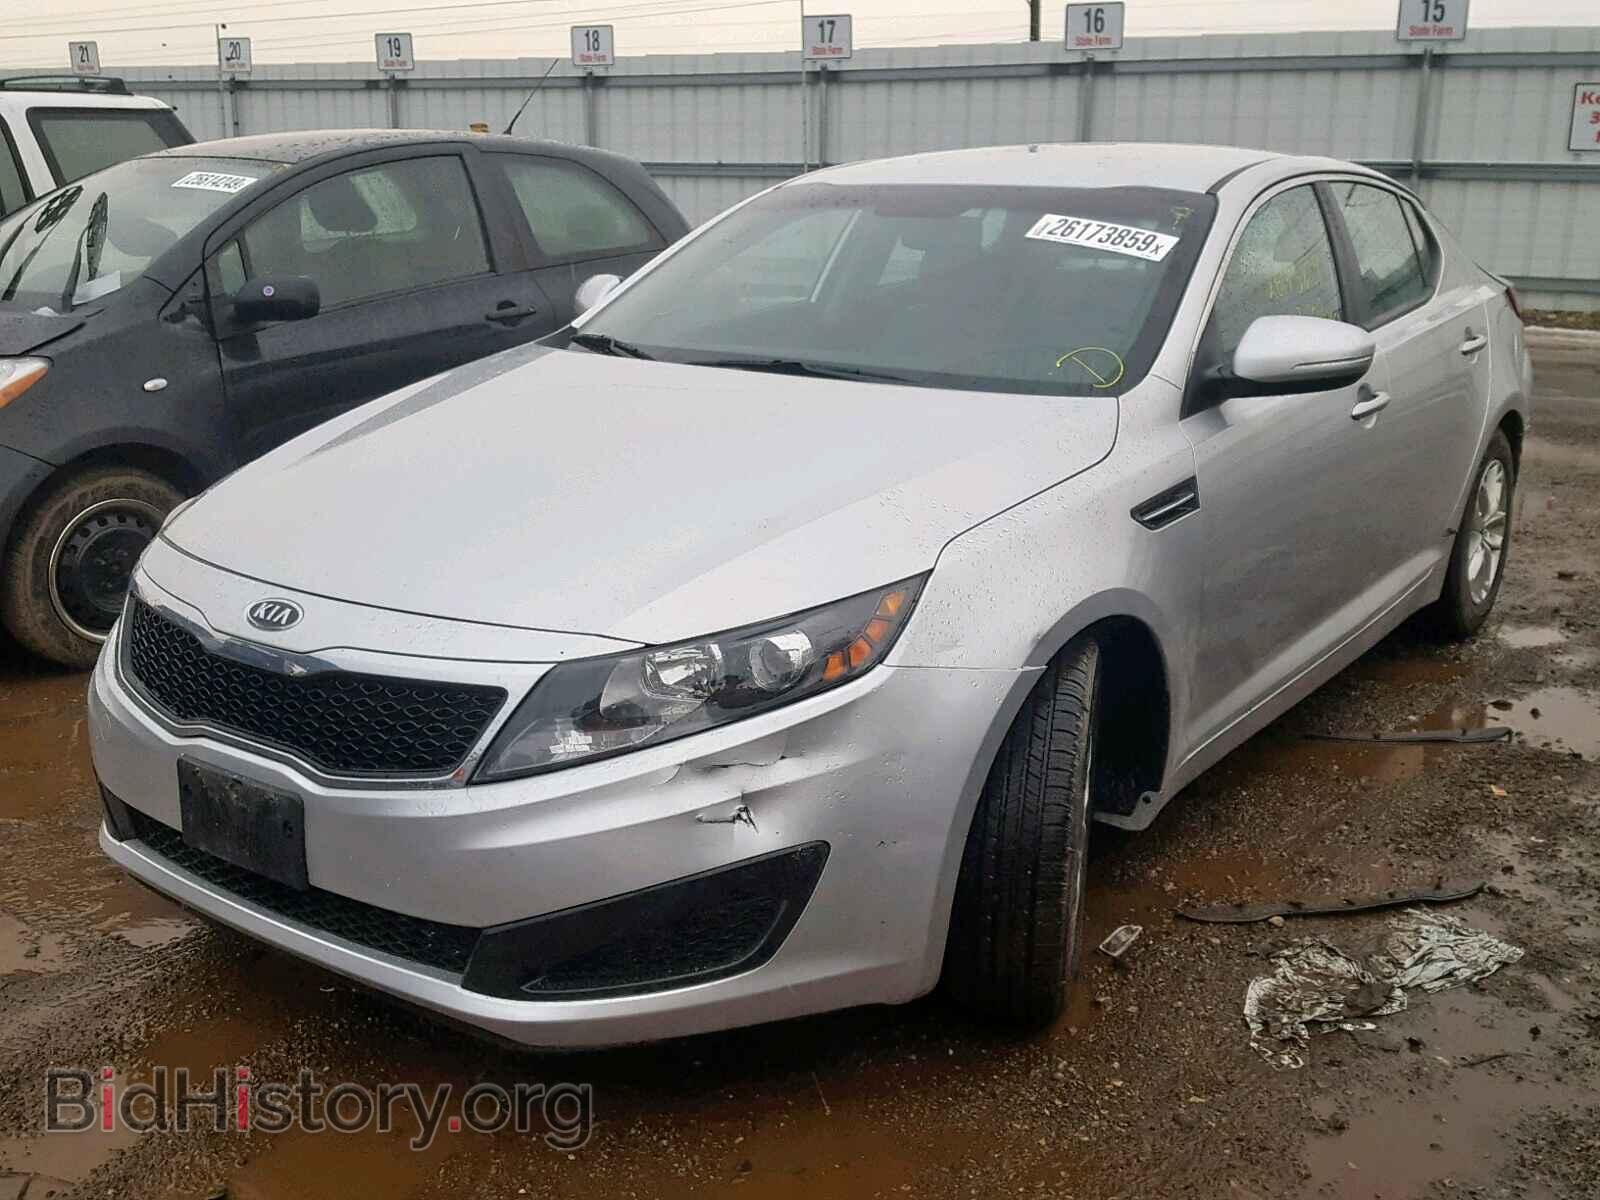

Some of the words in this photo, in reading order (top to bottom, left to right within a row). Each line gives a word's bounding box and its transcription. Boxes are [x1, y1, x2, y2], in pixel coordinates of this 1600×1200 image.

[1084, 8, 1105, 33] 16
[1423, 0, 1445, 22] 15
[584, 29, 600, 51] 18
[818, 20, 836, 43] 17
[79, 45, 89, 63] 21
[226, 41, 241, 60] 20
[387, 37, 401, 57] 19
[252, 602, 292, 625] KIA
